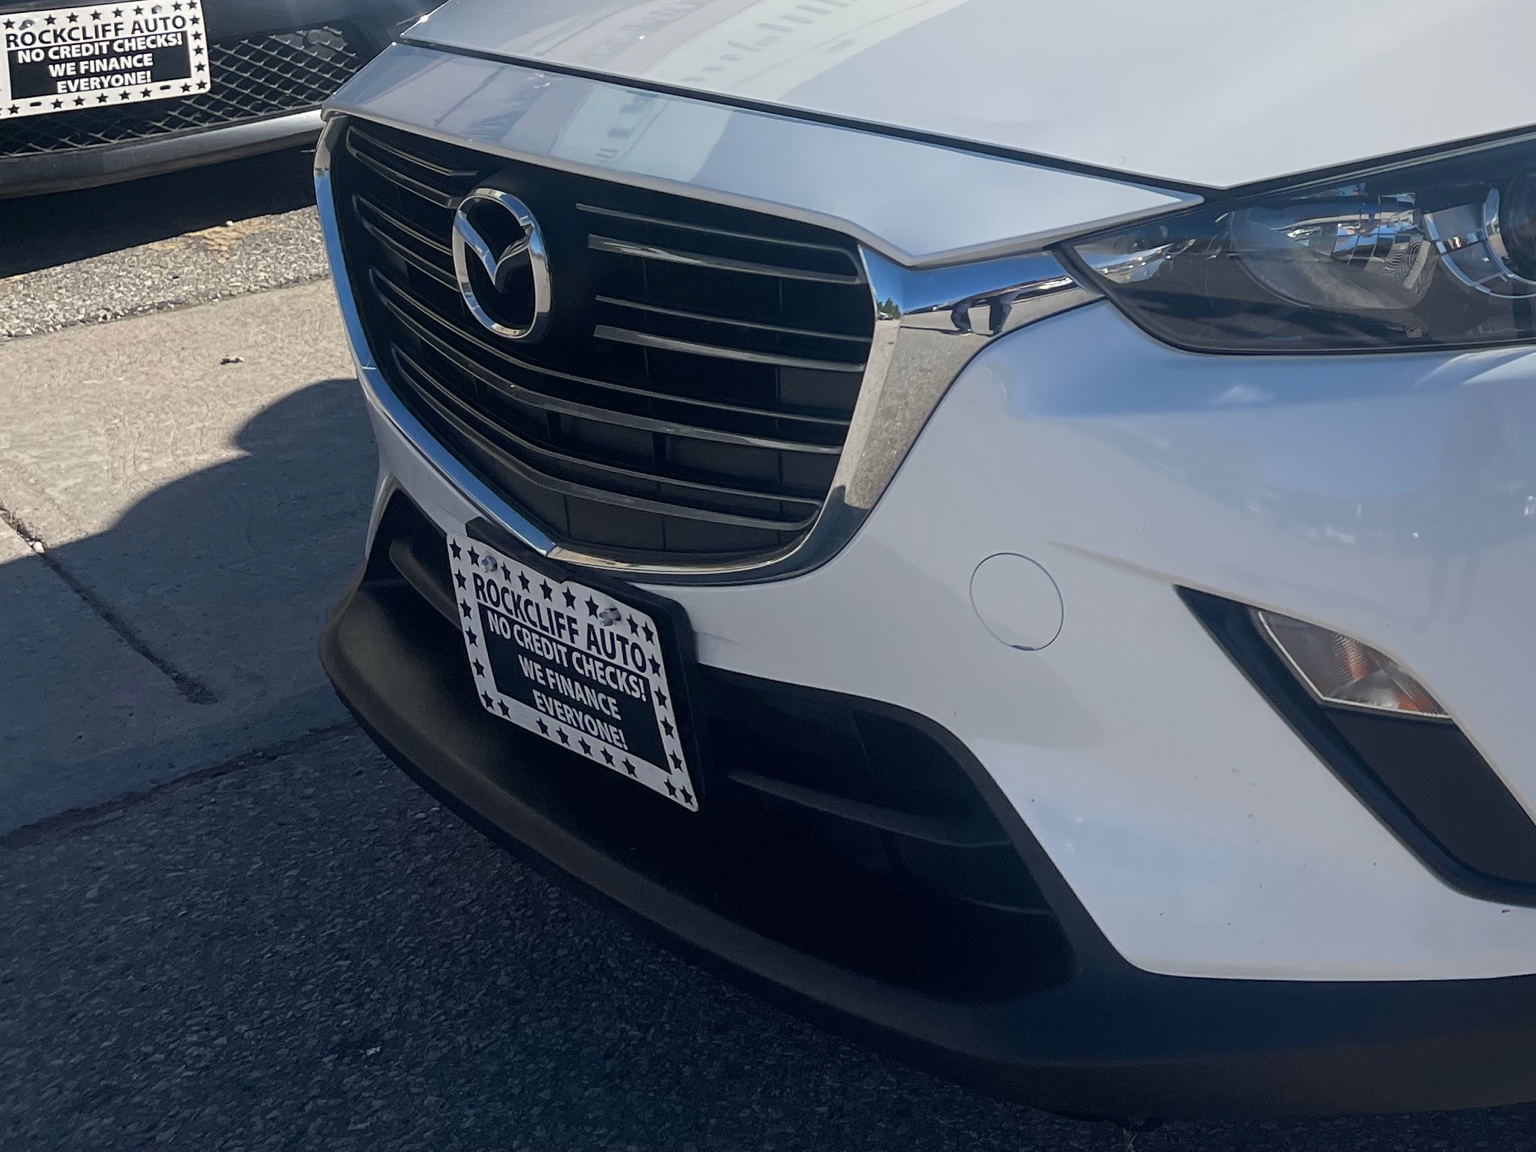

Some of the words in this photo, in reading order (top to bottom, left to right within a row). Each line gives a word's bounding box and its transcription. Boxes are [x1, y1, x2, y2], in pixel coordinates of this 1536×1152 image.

[6, 22, 125, 48] ROCKCLIFF
[131, 15, 187, 35] AUTO
[17, 49, 45, 64] NO
[48, 42, 110, 61] CREDIT
[113, 33, 183, 54] CHECKS!
[49, 63, 77, 78] WE
[80, 53, 154, 74] FINANCE
[57, 70, 152, 94] EVERYONE!
[472, 572, 580, 645] ROCKCLIFF
[587, 623, 647, 674] AUTO
[487, 610, 511, 640] NO
[513, 625, 569, 668] CREDIT
[572, 651, 648, 703] CHECKS!
[518, 654, 546, 684] WE
[545, 669, 622, 721] FINANCE
[532, 689, 629, 751] EVERYONE!
